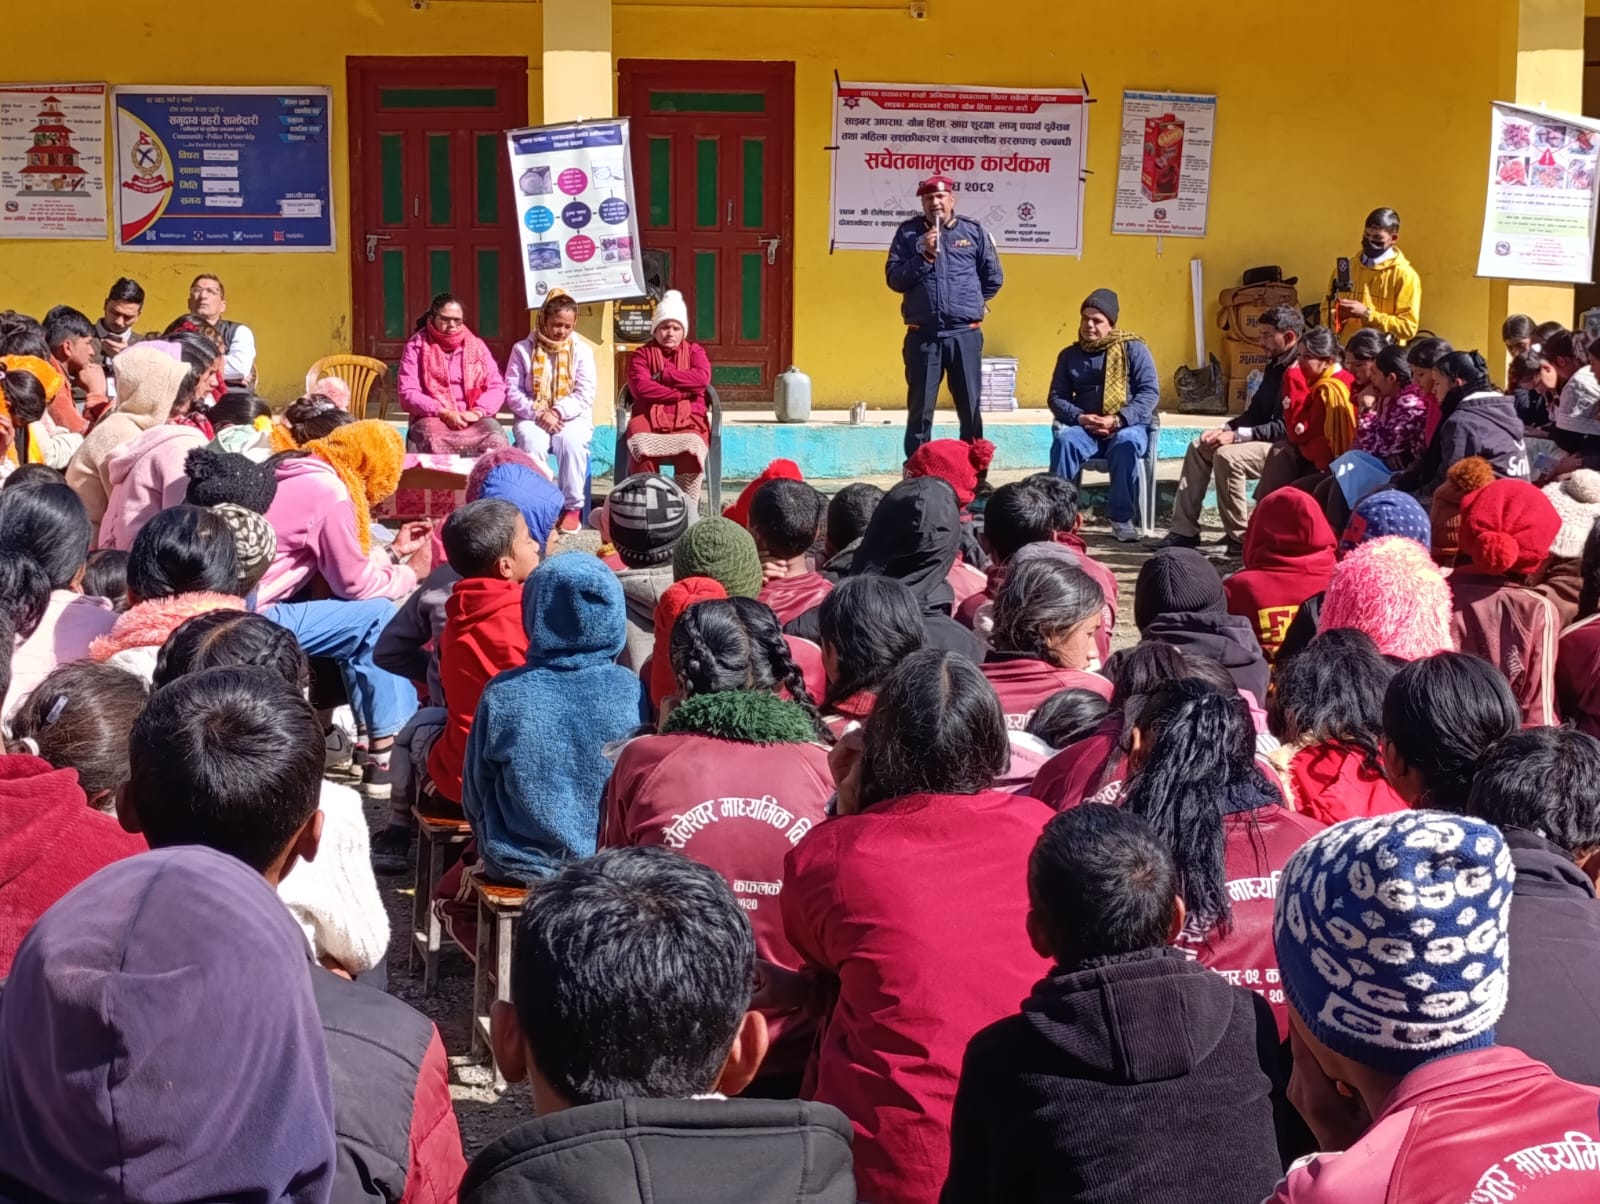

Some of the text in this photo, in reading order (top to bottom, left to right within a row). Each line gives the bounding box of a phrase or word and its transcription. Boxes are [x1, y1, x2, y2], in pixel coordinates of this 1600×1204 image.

[844, 117, 871, 126] साइबर
[906, 116, 924, 127] यौन
[998, 121, 1018, 132] लागु
[841, 132, 858, 141] तथा
[860, 130, 888, 142] महिला
[942, 135, 950, 144] र
[950, 134, 996, 145] वातावरणीय
[964, 181, 995, 193] २०८२
[718, 794, 794, 830] माध्यमिक
[1504, 1130, 1600, 1183] माध्यमि
